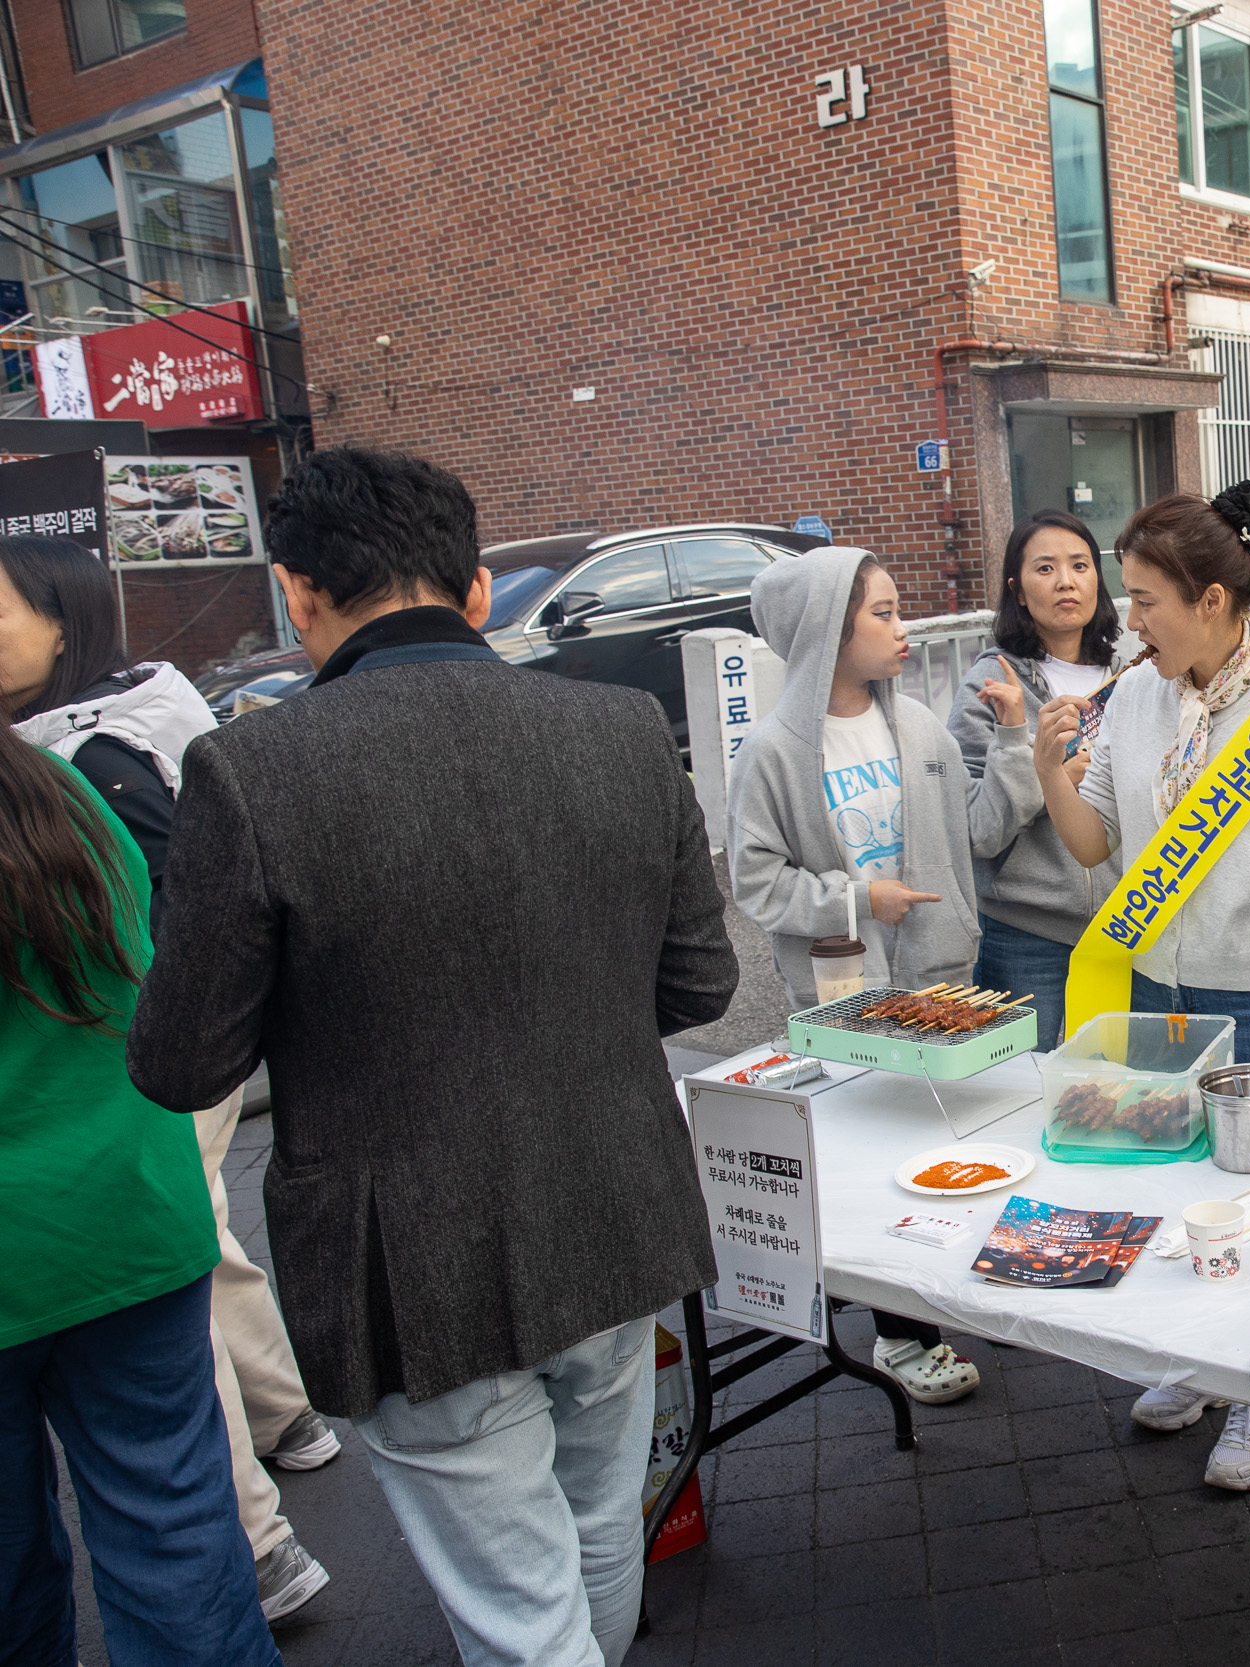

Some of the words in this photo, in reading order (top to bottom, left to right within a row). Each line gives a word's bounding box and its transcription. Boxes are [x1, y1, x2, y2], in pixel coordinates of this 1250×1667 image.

[815, 64, 870, 128] 라
[924, 456, 938, 468] 66
[7, 516, 31, 536] 중국
[33, 510, 70, 536] 백주의
[71, 507, 97, 534] 걸작
[704, 1145, 714, 1160] 한
[716, 1147, 736, 1164] 사람
[738, 1152, 749, 1167] 당
[751, 1154, 767, 1171] 2개
[769, 1158, 801, 1178] 꼬치씩
[708, 1166, 746, 1188] 무료시식
[749, 1175, 800, 1199] 가능합니다
[725, 1204, 764, 1225] 차례대로
[766, 1213, 787, 1232] 줄을
[716, 1223, 726, 1239] 서
[728, 1226, 757, 1246] 주시길
[760, 1233, 801, 1256] 바랍니다
